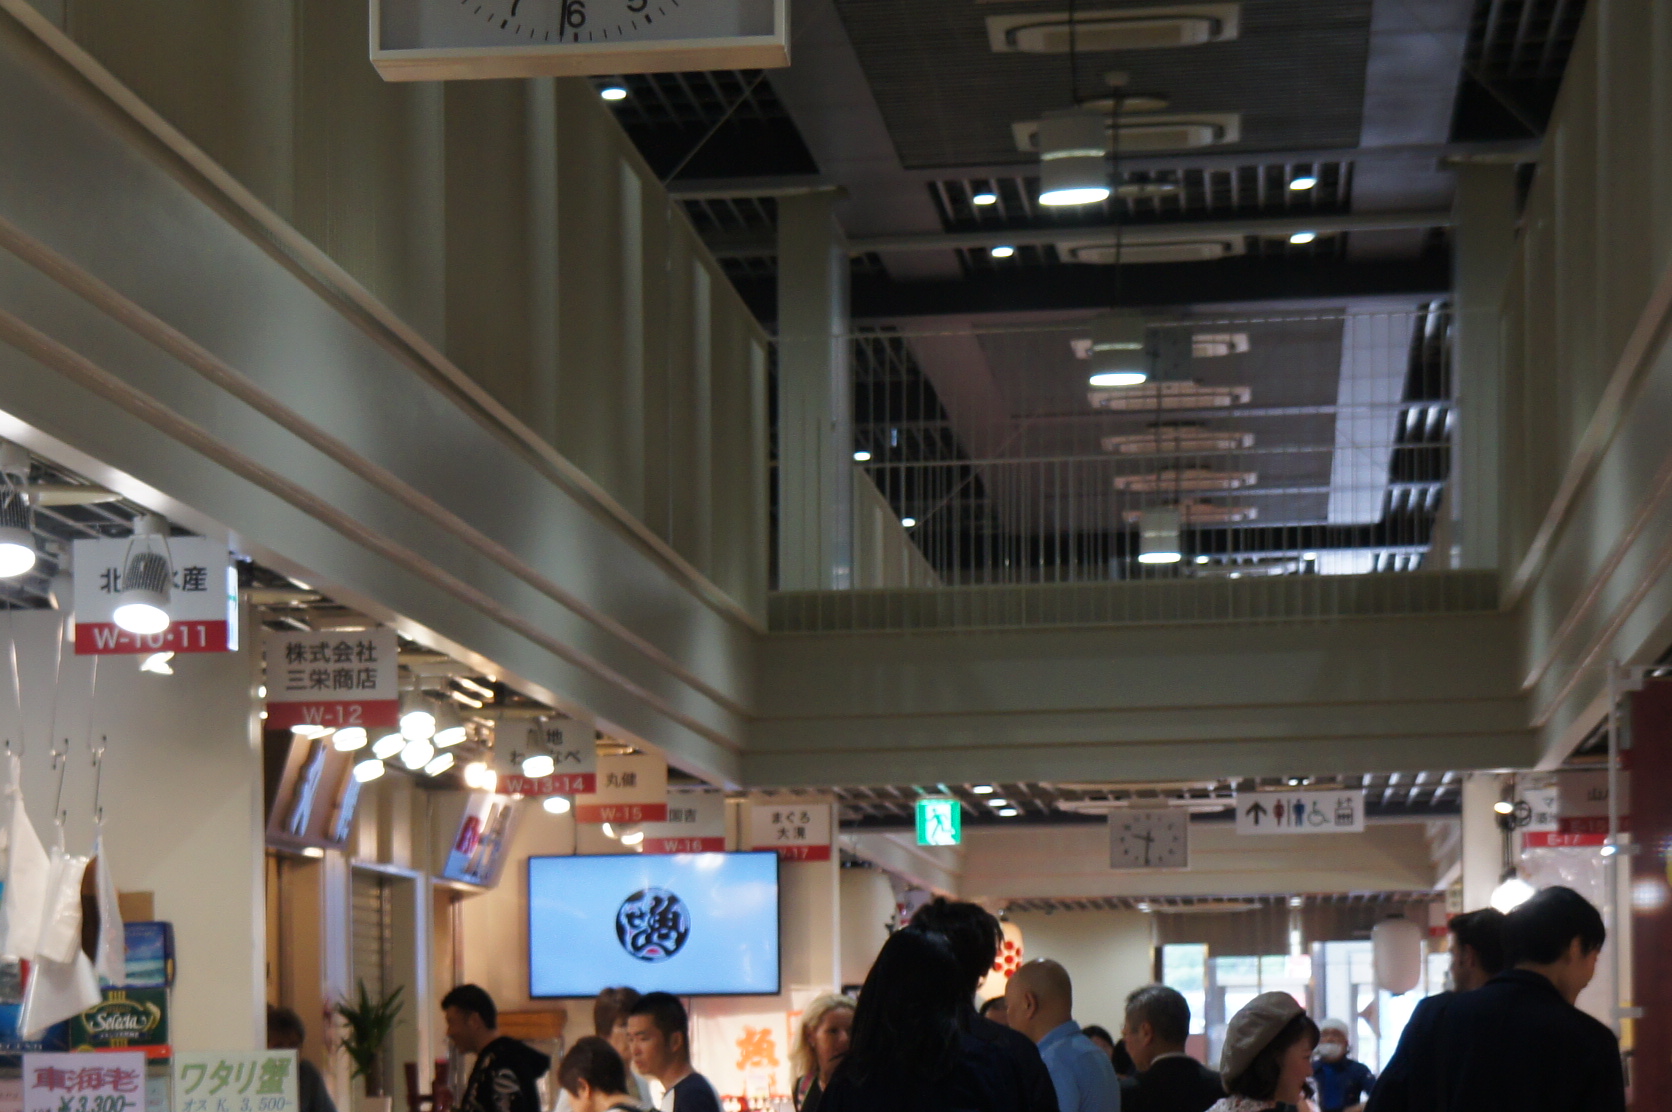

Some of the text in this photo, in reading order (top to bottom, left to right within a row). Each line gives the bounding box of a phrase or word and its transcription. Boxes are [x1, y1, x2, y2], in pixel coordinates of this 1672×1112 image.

[566, 0, 586, 28] 6
[100, 566, 208, 594] 北産
[285, 640, 379, 665] 株式会社
[285, 667, 378, 692] 三栄商店
[302, 705, 364, 725] W-12
[599, 807, 643, 821] W-15
[771, 810, 811, 824] まぐろ
[31, 1066, 140, 1094] 車海老
[180, 1057, 293, 1096] ワタリ蟹
